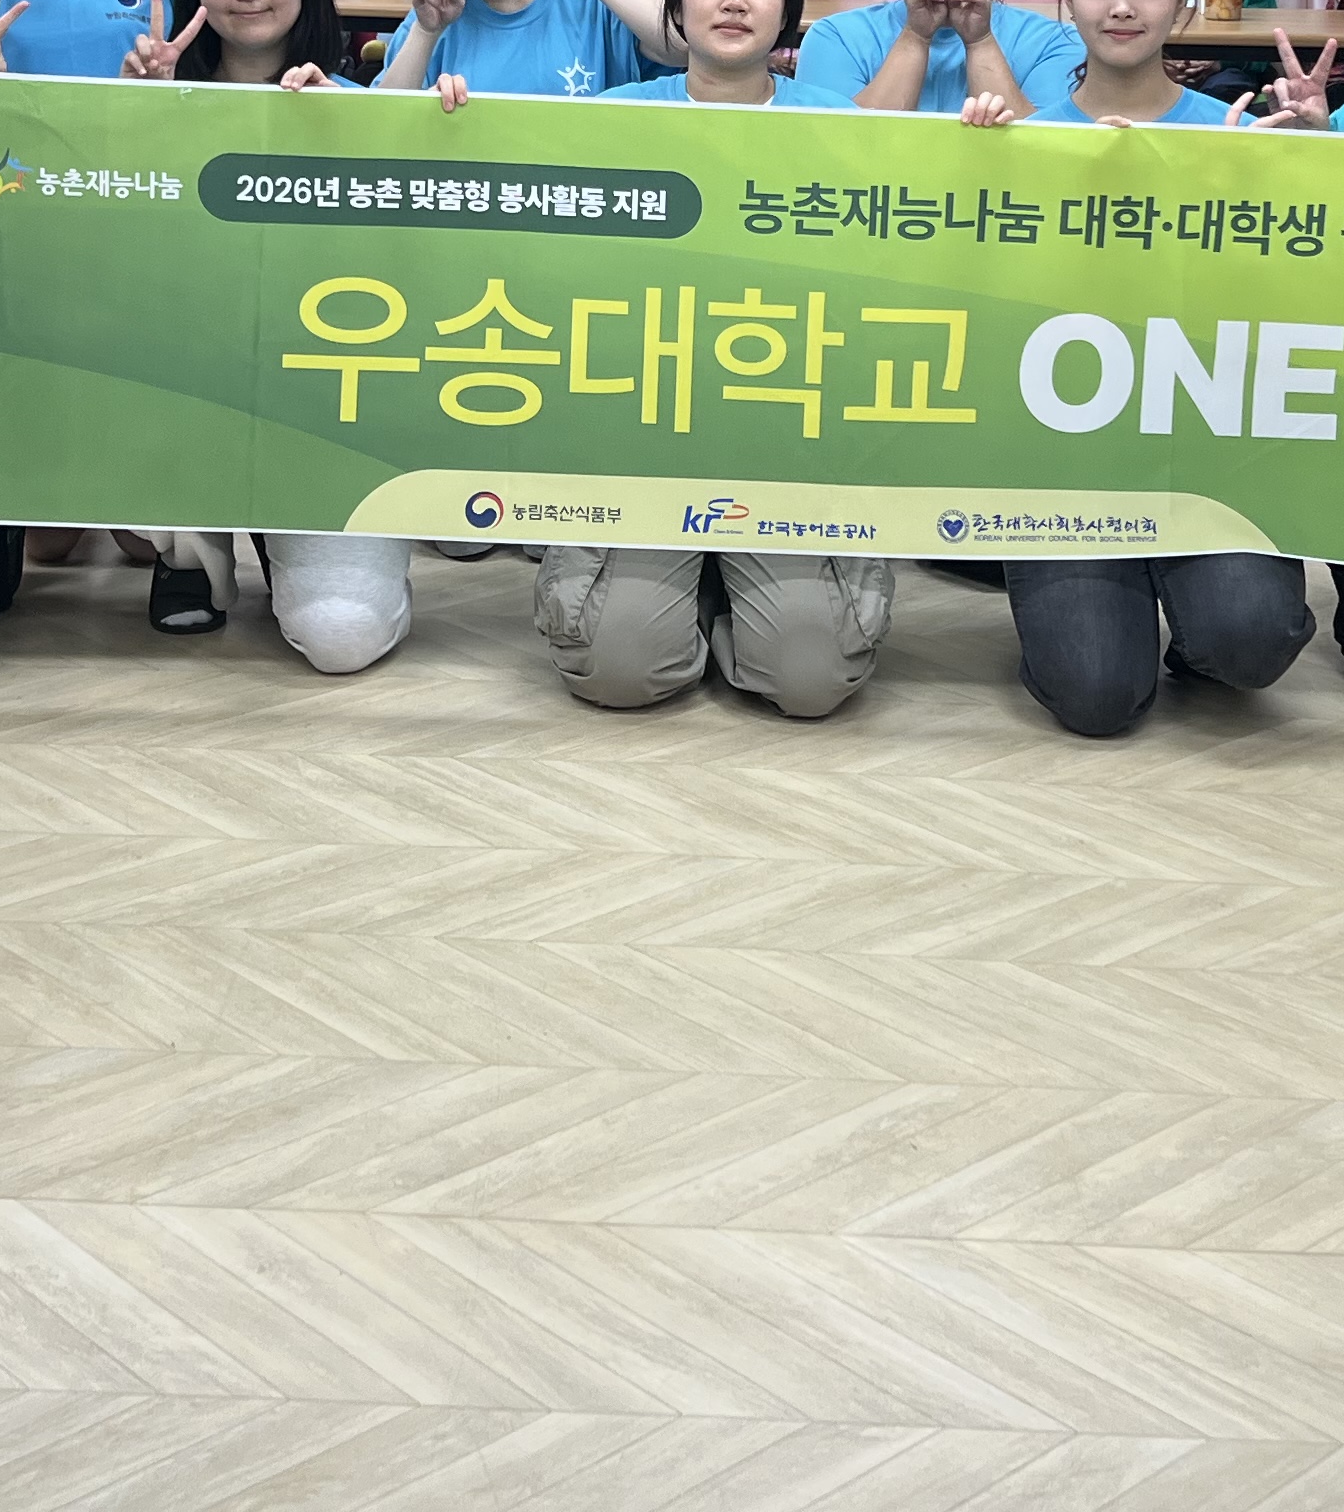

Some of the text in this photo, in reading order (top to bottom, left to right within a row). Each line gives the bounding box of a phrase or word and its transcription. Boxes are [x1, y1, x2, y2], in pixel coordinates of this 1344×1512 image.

[36, 167, 183, 201] 농촌재능나눔
[235, 175, 668, 222] 2026년 농촌 맞춤형 봉사활동 지원
[738, 180, 1044, 246] 농촌재능나눔
[281, 277, 978, 440] 우송대학교
[512, 503, 623, 524] 농림축산식품부
[972, 513, 1158, 535] 한국대학사회봉사협의회
[757, 520, 877, 541] 한국농어촌공사
[974, 535, 1158, 543] KOREAN UNIVERSITY COUNCIL FOR SOCIAL SERVICE
